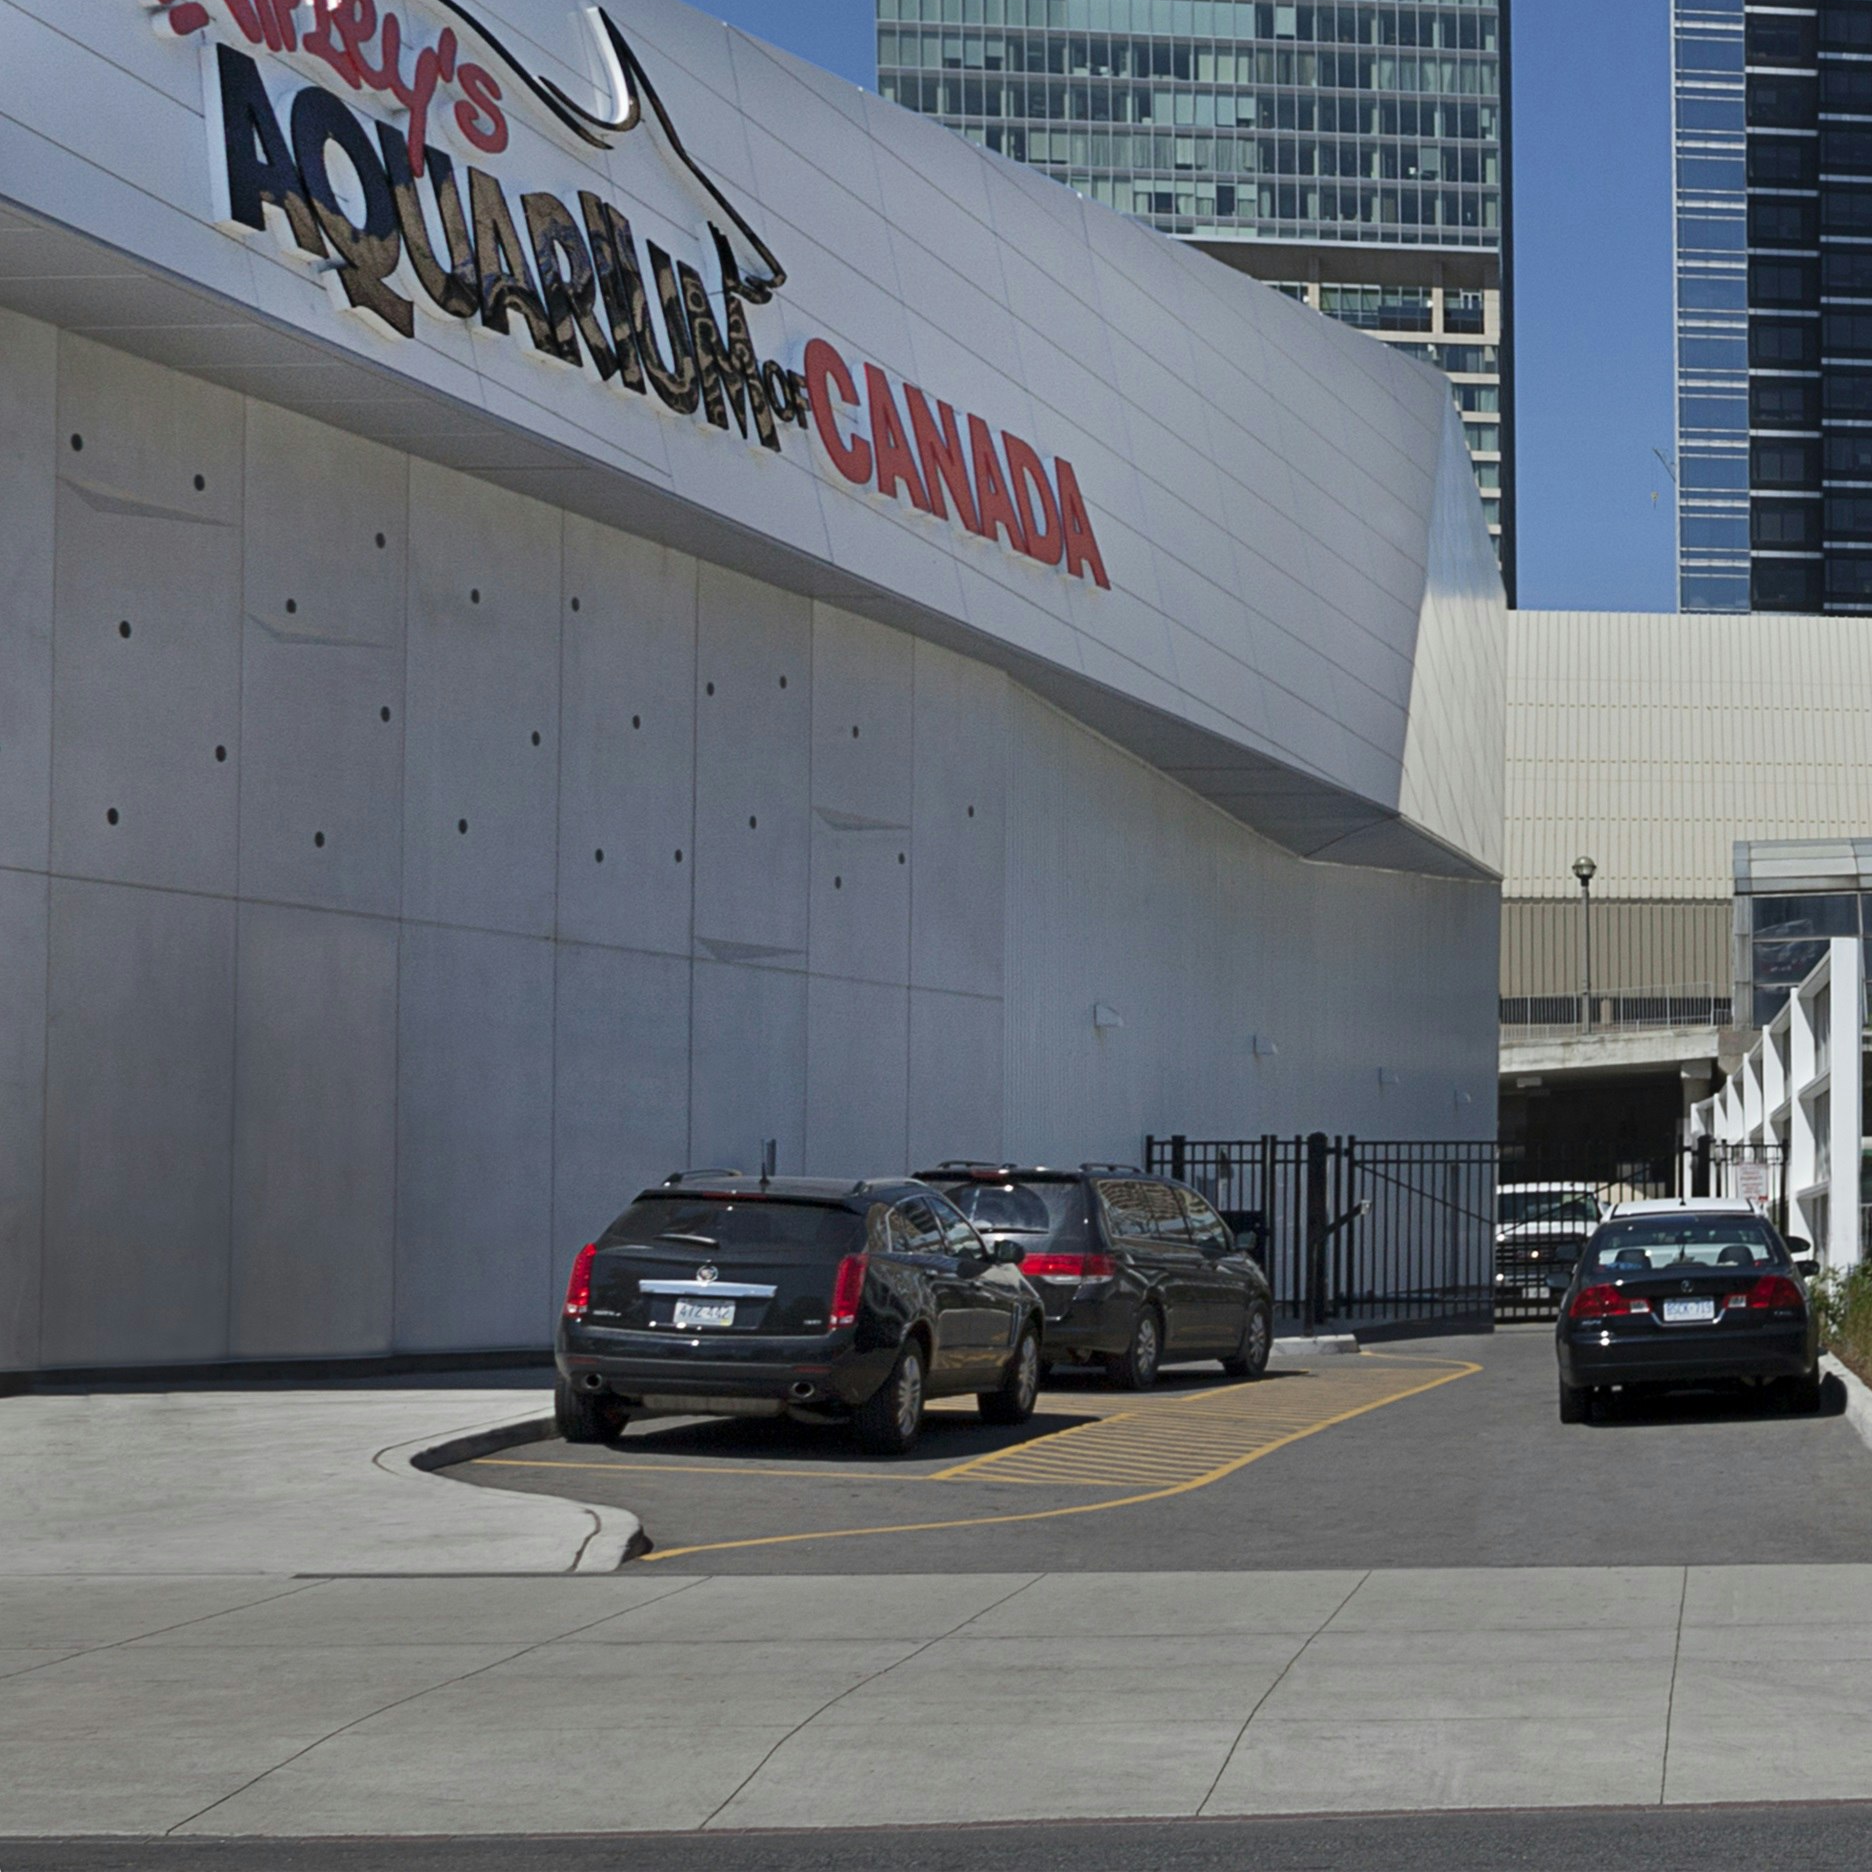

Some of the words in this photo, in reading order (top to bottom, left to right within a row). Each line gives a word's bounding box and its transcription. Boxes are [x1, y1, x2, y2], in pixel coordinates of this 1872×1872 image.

[214, 42, 782, 453] AQUARIUM
[762, 359, 812, 430] OF
[804, 337, 1110, 590] CANADA
